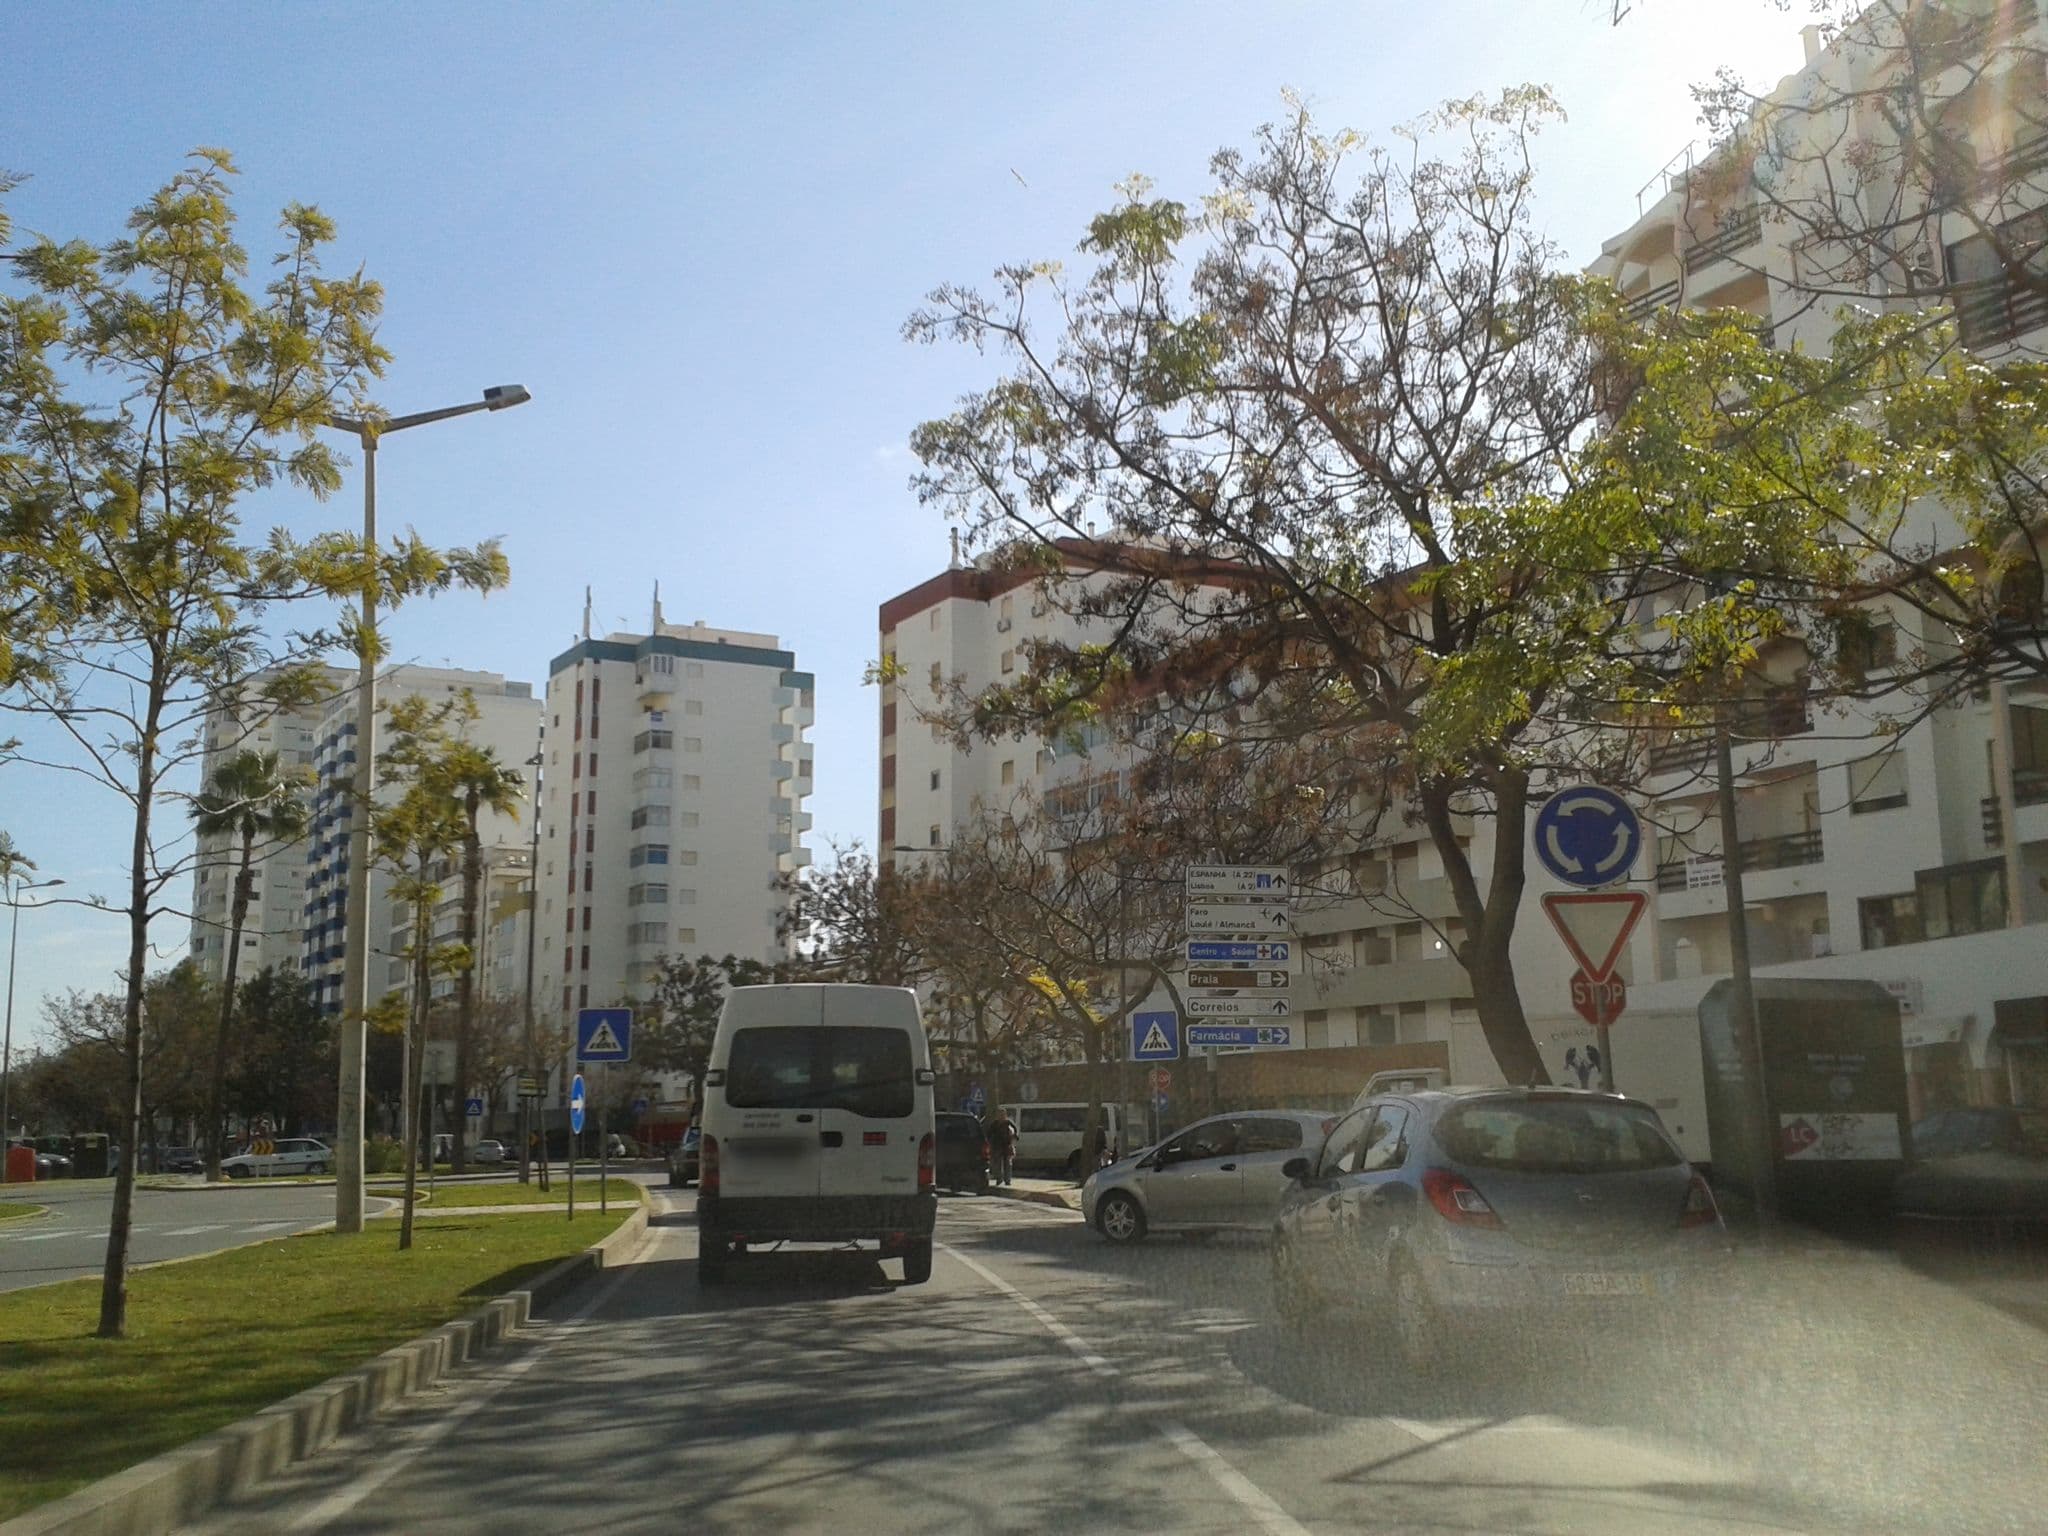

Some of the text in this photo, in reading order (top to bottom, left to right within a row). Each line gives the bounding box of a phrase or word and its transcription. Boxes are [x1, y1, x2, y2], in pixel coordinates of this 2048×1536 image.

[1190, 974, 1219, 984] Praia
[1190, 1002, 1239, 1012] Correios
[1190, 1030, 1240, 1041] Farmácia
